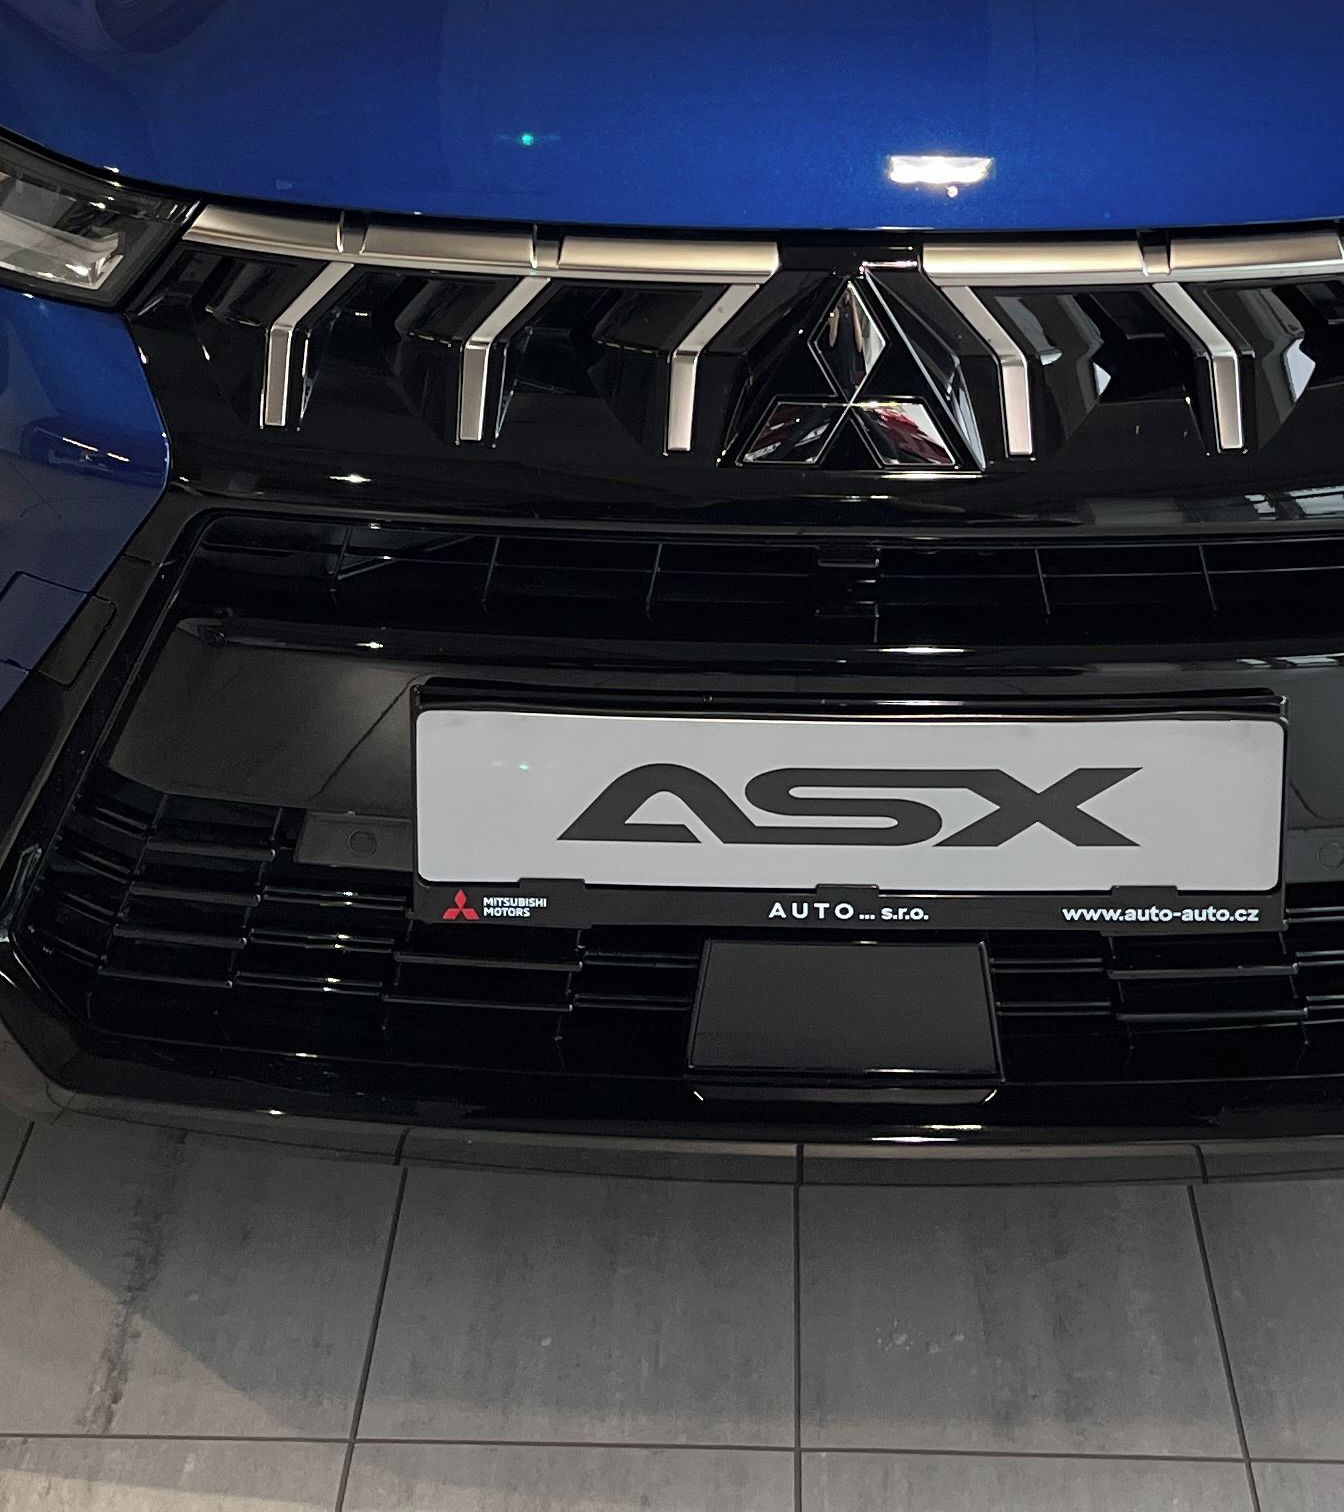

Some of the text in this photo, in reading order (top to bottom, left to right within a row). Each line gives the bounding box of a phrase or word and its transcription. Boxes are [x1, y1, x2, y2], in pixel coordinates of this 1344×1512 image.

[556, 763, 1144, 847] ASX
[483, 897, 547, 908] MITSUBISHI
[483, 907, 531, 917] MOTORS
[881, 907, 929, 921] s.r.o.
[1062, 905, 1259, 922] www.auto-auto.cz
